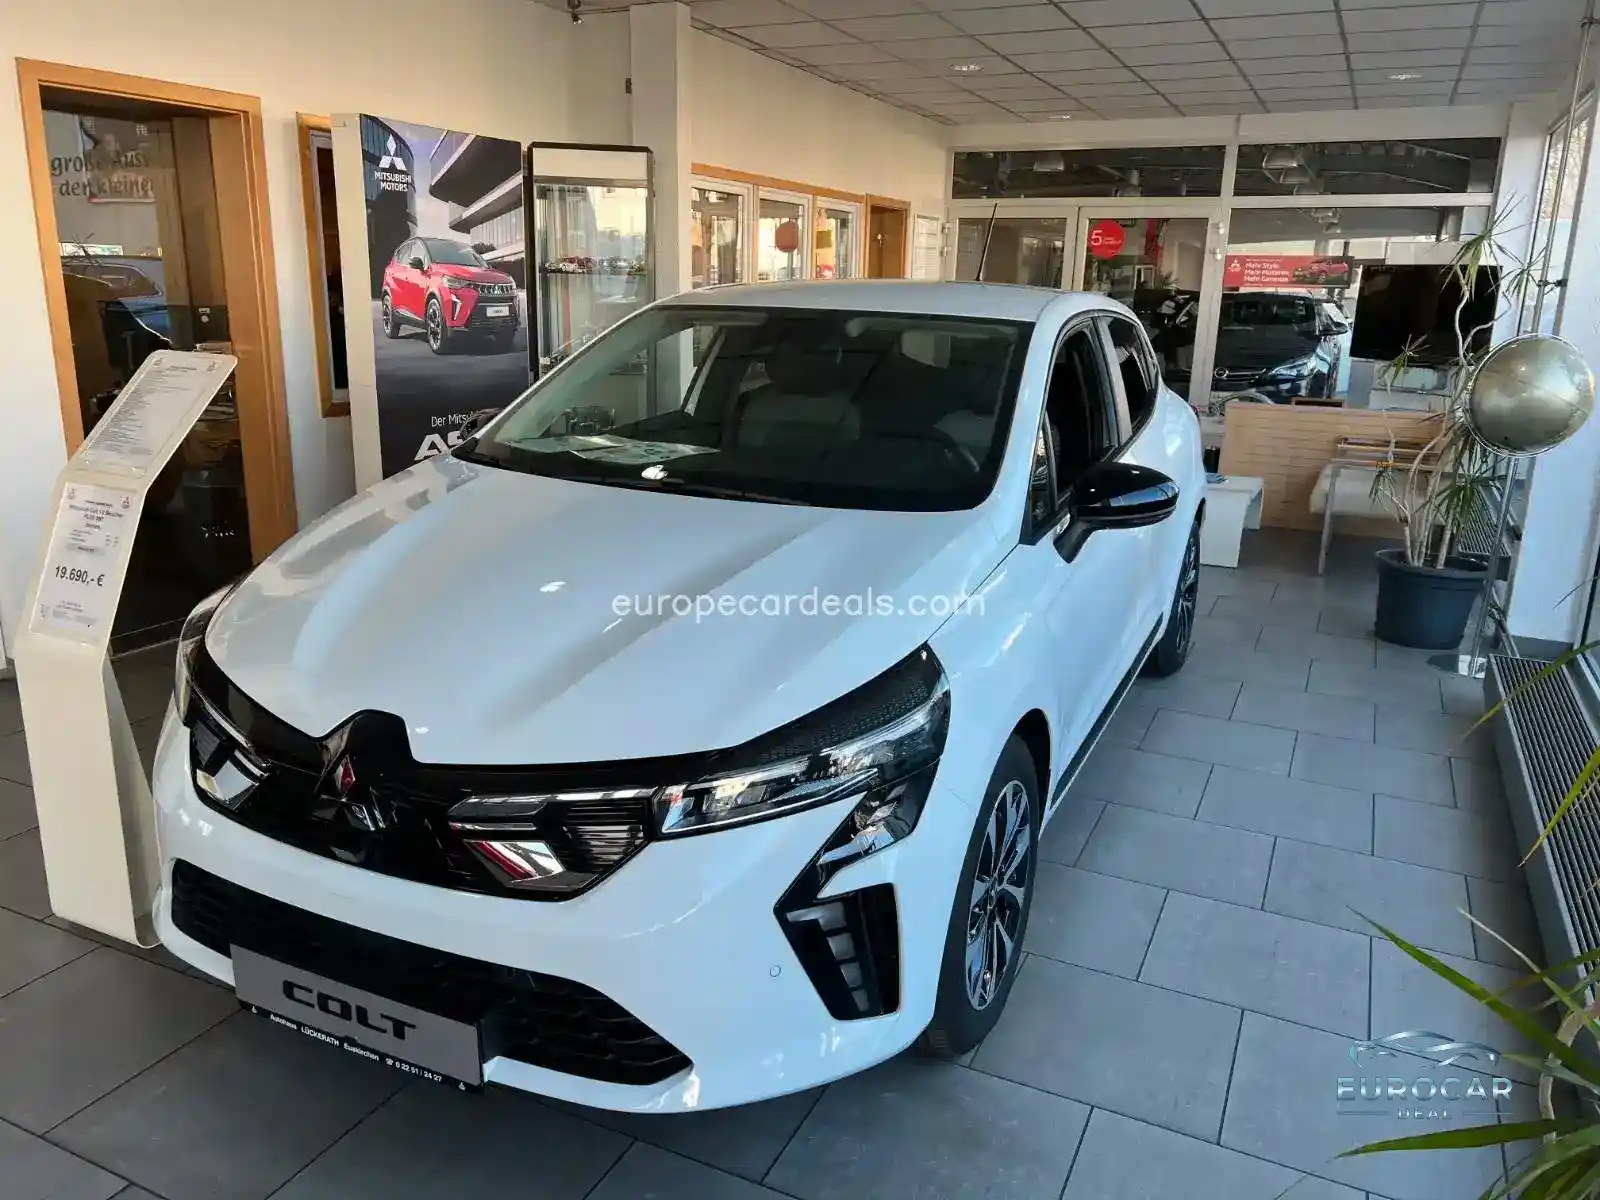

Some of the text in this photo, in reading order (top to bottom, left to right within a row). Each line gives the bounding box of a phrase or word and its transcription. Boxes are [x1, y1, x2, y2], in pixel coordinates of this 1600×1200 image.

[374, 171, 412, 183] MITSUBISHI
[380, 181, 408, 192] MOTORS
[1091, 229, 1102, 246] 5
[431, 416, 446, 427] Der
[97, 574, 105, 587] €
[282, 980, 417, 1041] COLT
[270, 1014, 298, 1030] Autohaus
[301, 1025, 340, 1047] LÜCKERATH
[343, 1042, 380, 1062] Euskirchen
